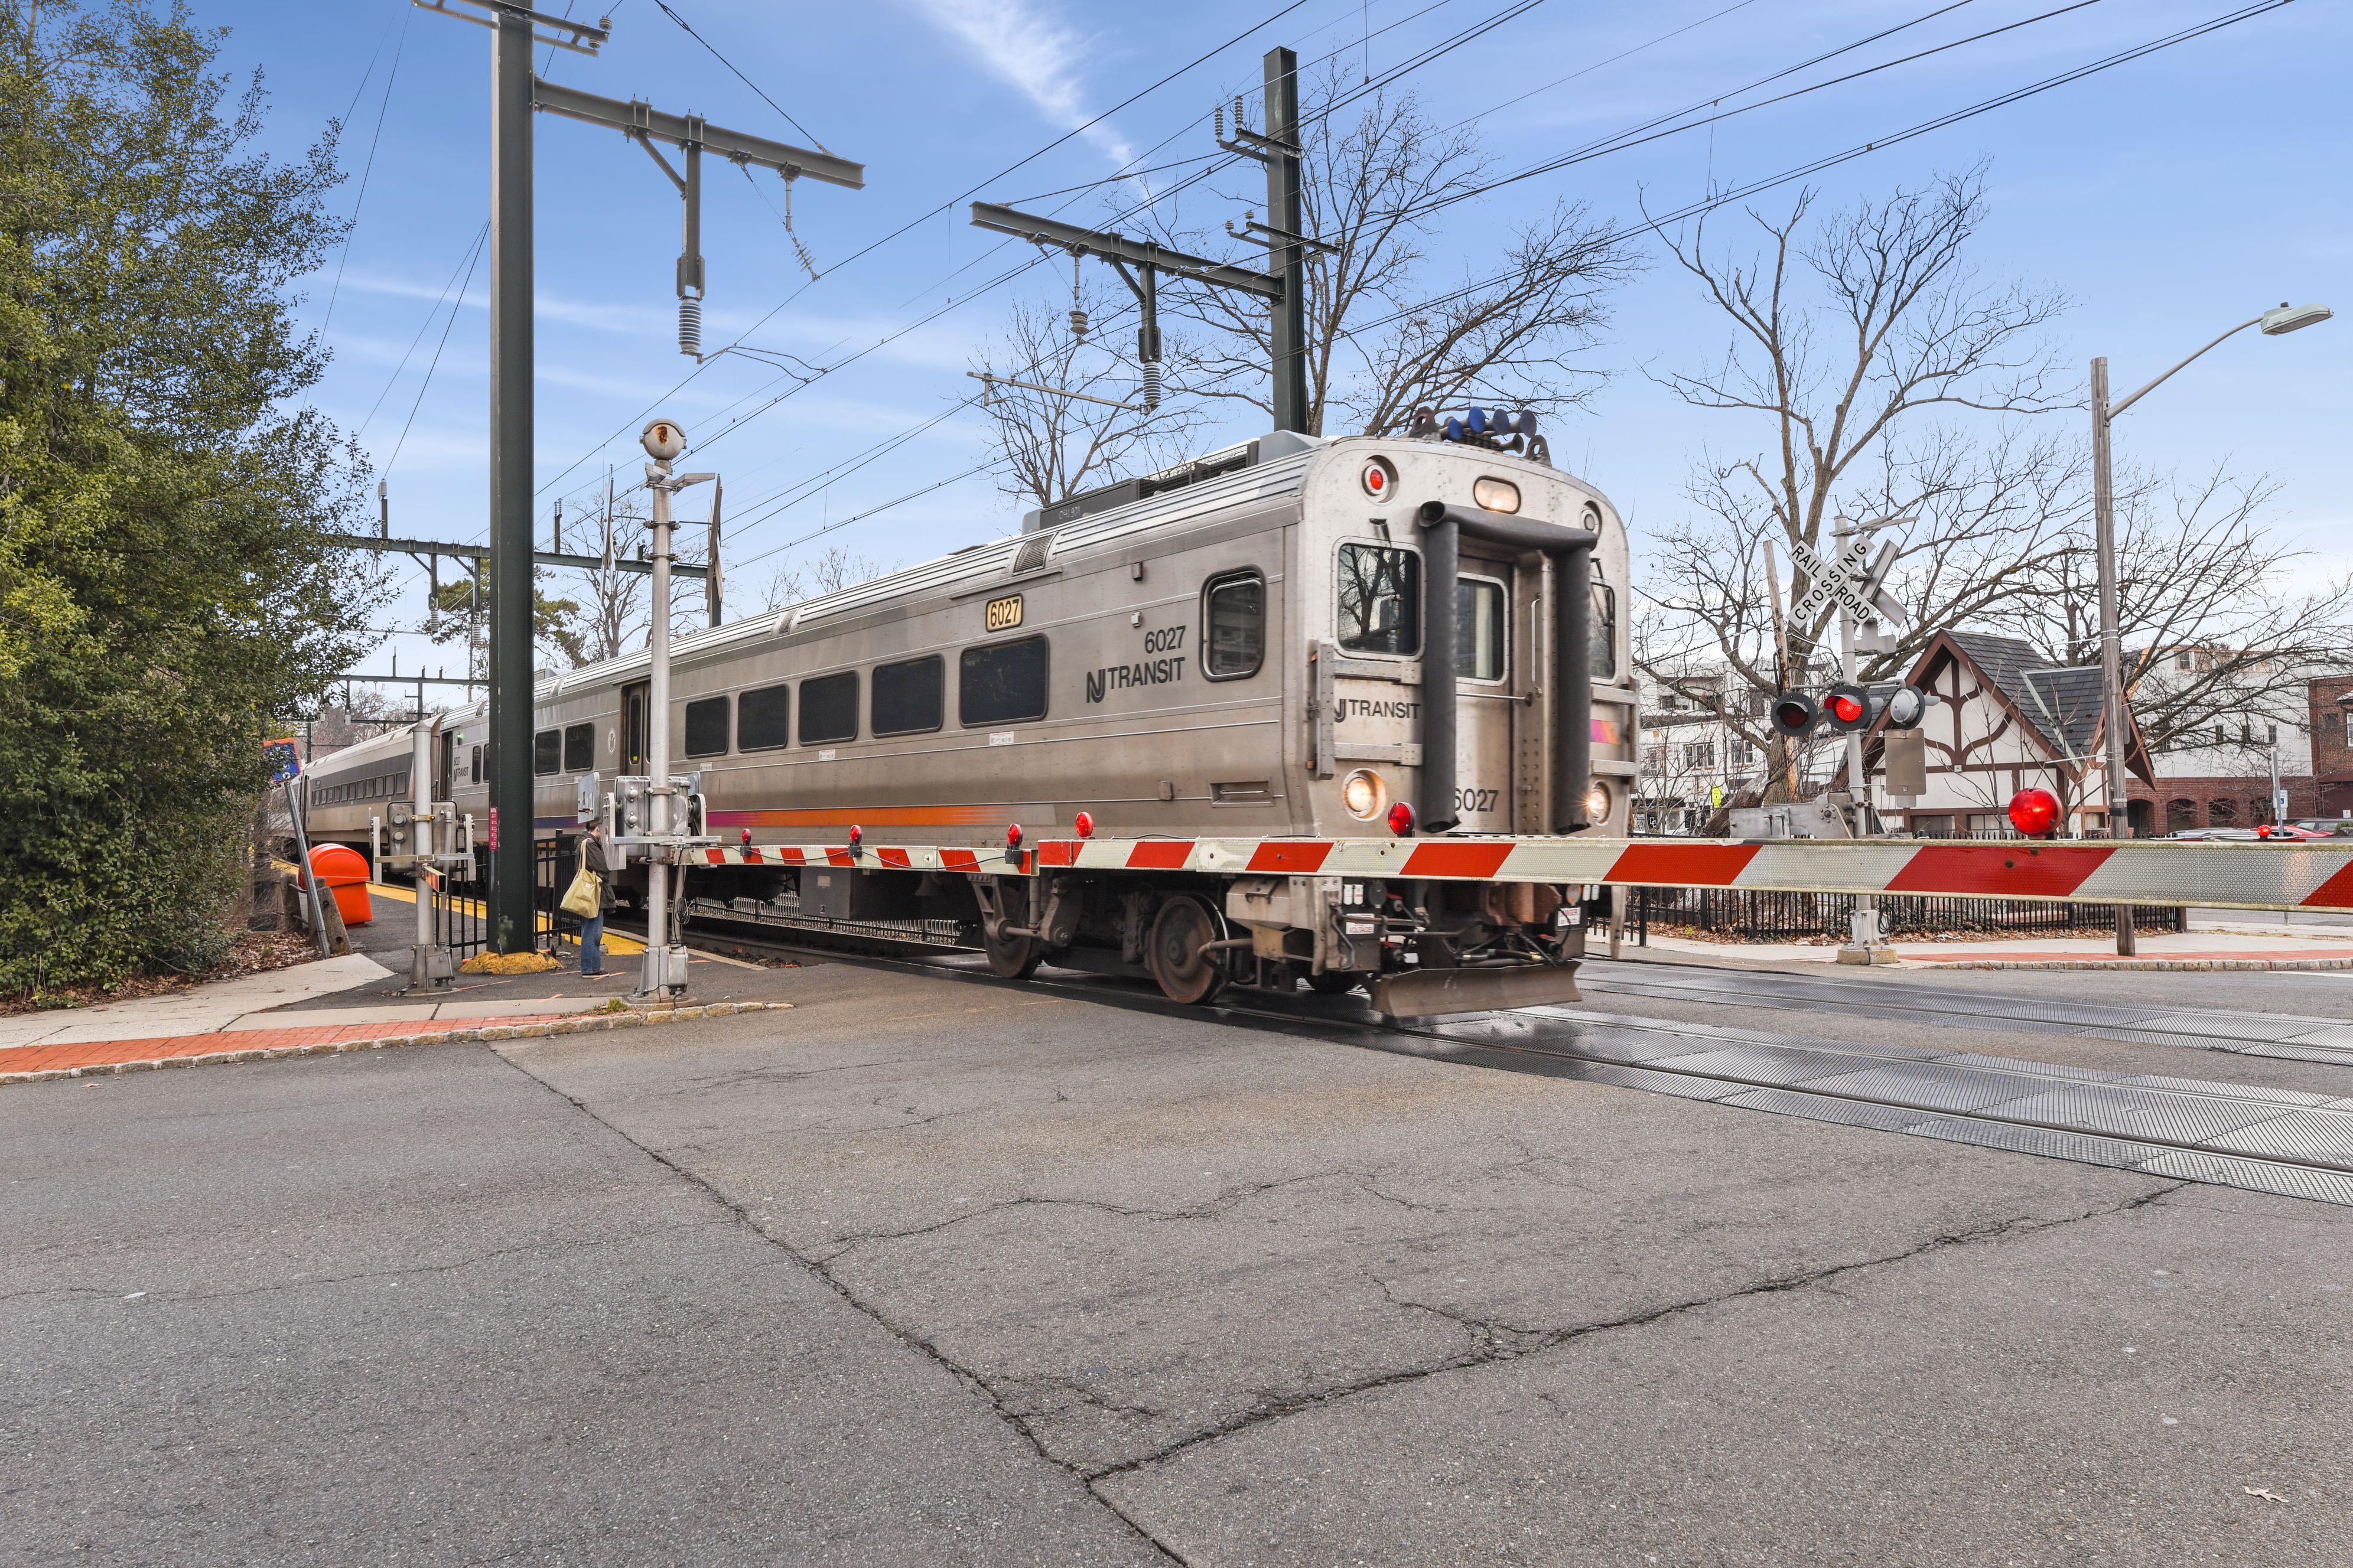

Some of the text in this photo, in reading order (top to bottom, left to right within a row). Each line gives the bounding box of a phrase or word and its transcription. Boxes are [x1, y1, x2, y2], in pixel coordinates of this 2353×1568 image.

[1792, 546, 1870, 620] RAIL ROAD
[1795, 543, 1866, 620] CROSSING
[991, 598, 1020, 627] 6027
[1145, 625, 1186, 654] 6027
